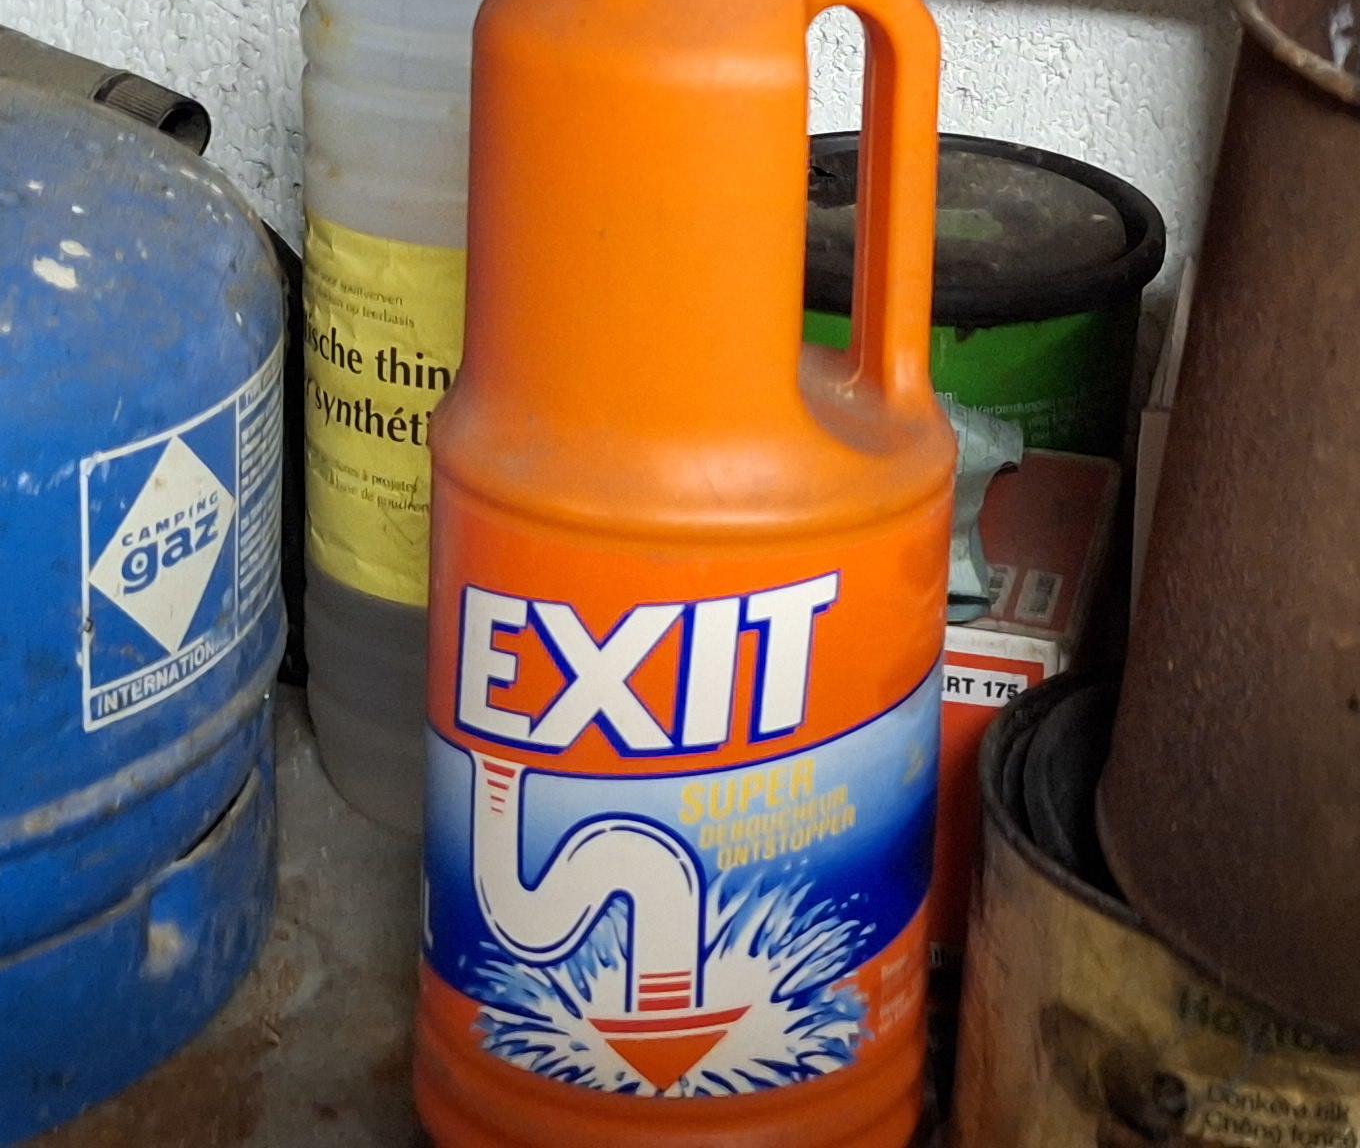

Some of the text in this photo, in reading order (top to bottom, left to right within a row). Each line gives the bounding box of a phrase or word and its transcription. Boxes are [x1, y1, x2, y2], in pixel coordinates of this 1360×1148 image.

[375, 346, 456, 392] thin
[120, 490, 219, 548] CAMPING
[120, 508, 220, 597] gaz
[455, 570, 841, 758] EXIT
[942, 675, 1019, 700] RT 175
[679, 758, 817, 826] SUPER
[717, 805, 857, 871] ONTSTOPPER
